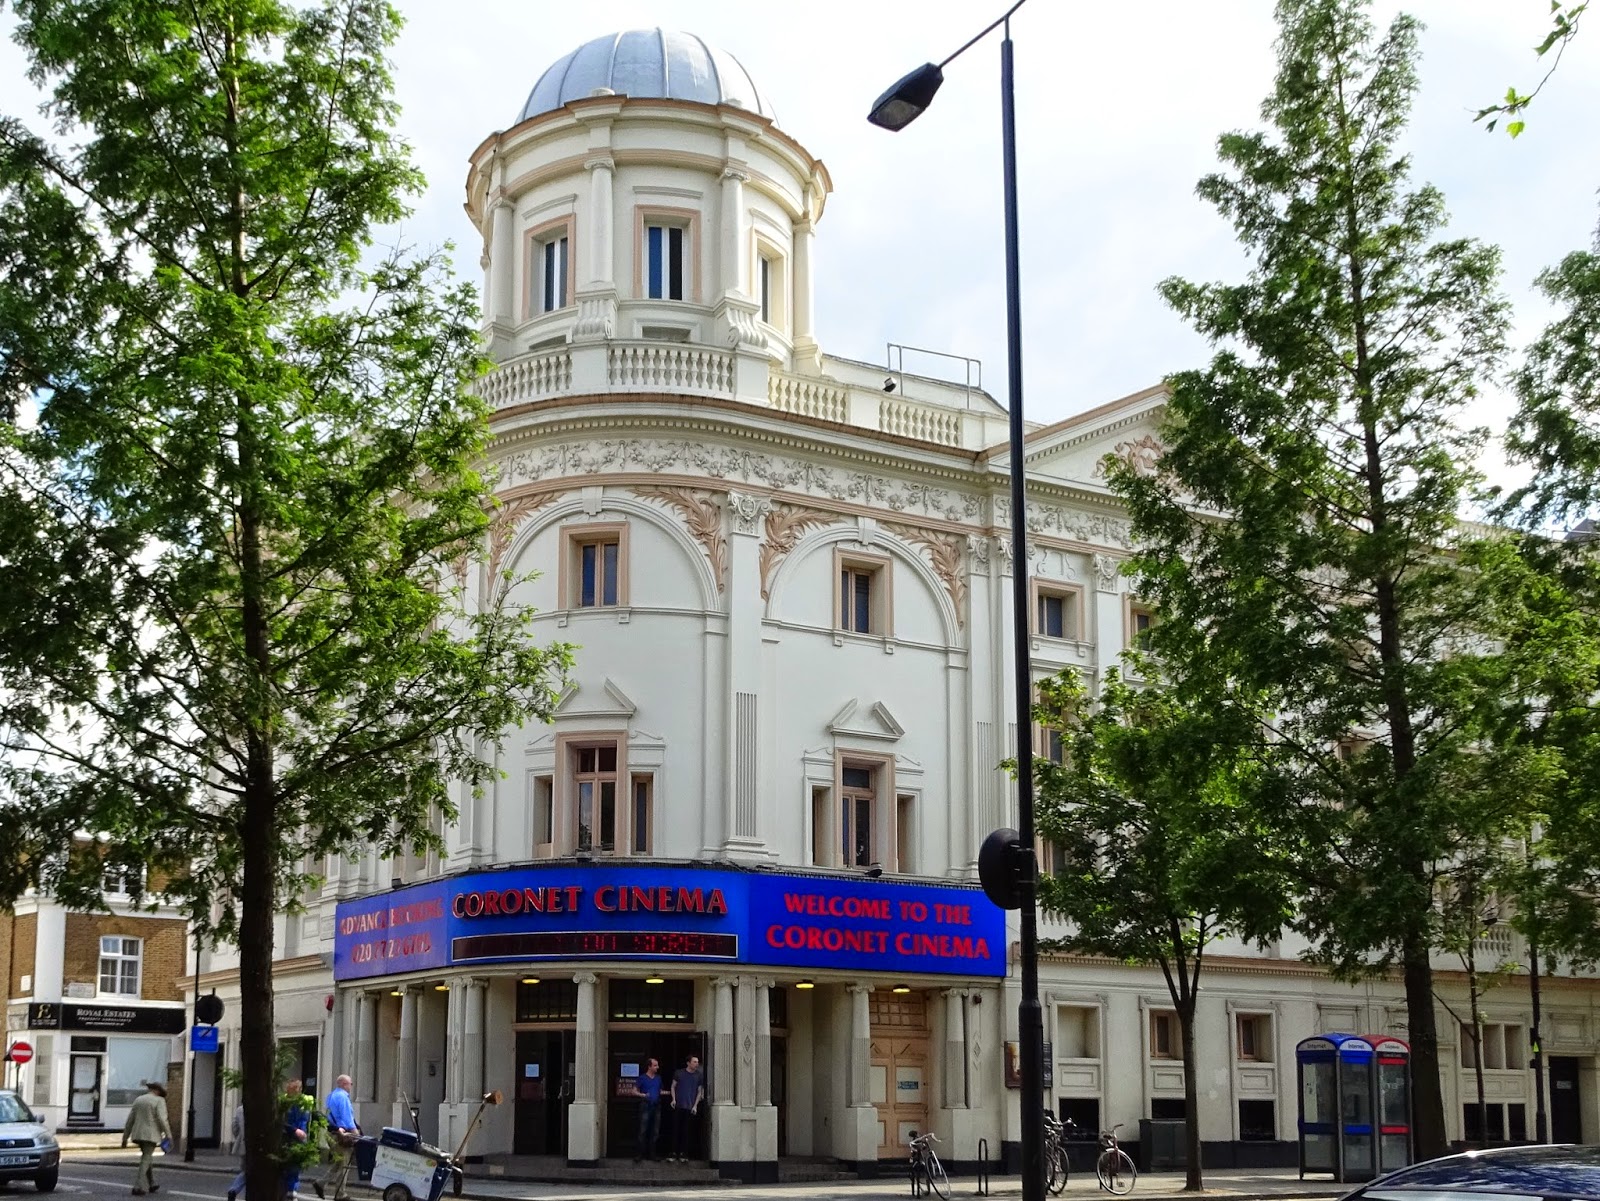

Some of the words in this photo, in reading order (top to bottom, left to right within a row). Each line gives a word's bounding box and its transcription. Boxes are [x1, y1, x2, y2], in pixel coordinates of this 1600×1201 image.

[452, 886, 582, 918] CORONET
[594, 885, 728, 914] CINEMA
[784, 893, 892, 920] WELCOME
[899, 900, 928, 922] TO
[933, 903, 972, 925] THE
[766, 925, 889, 953] CORONET
[895, 932, 990, 959] CINEMA
